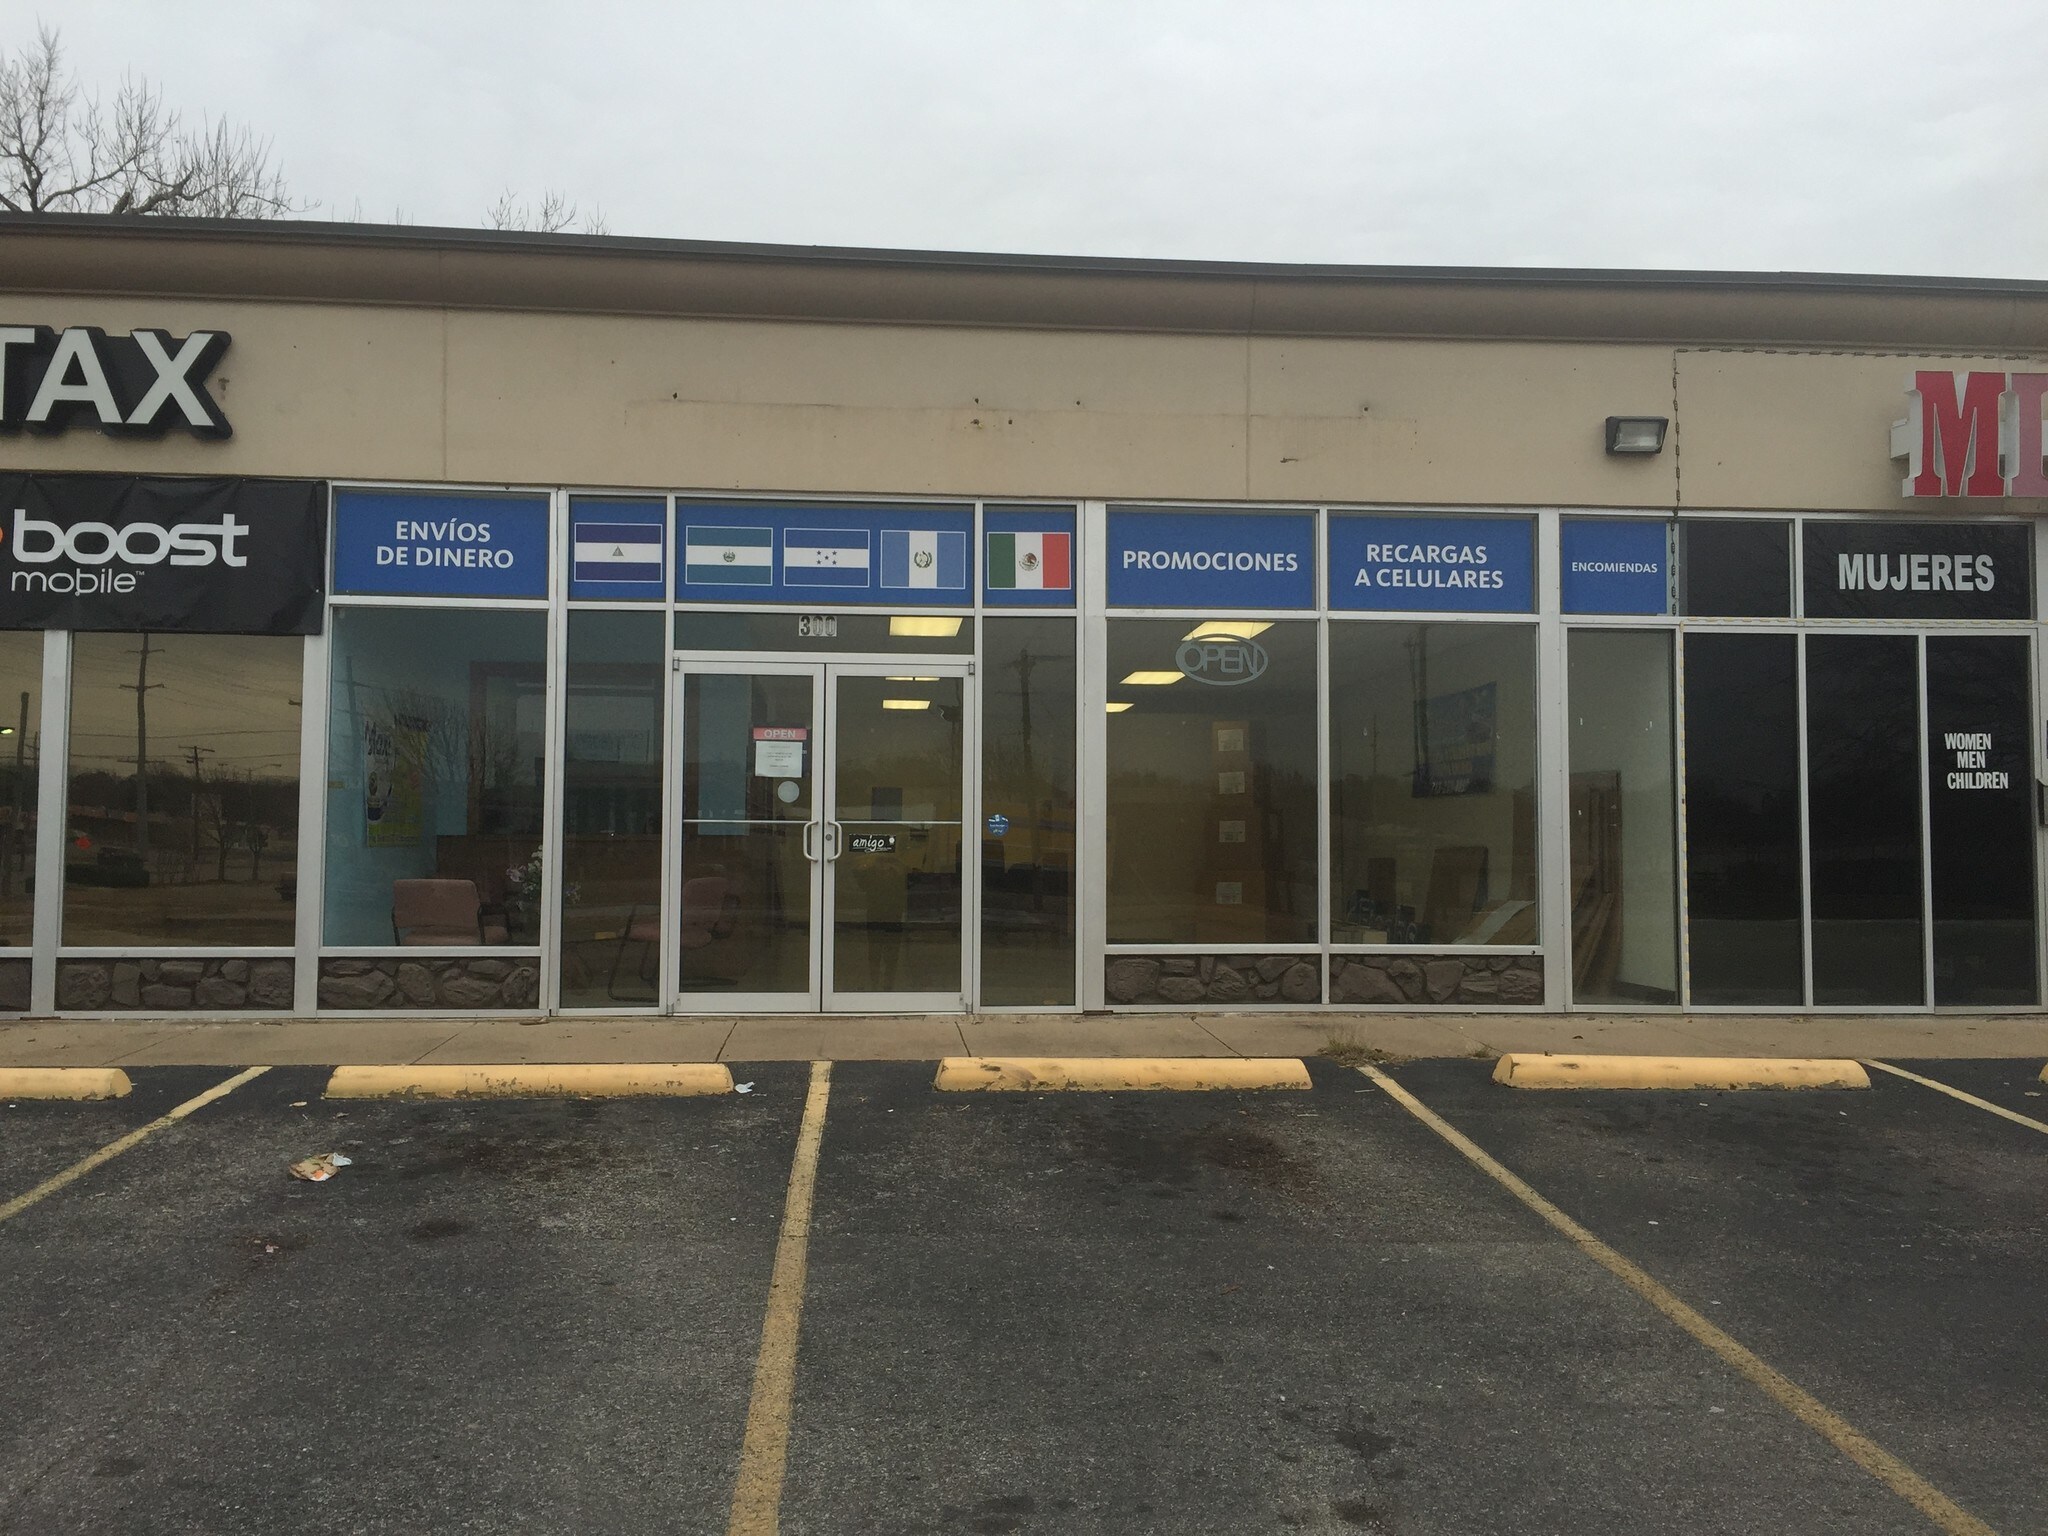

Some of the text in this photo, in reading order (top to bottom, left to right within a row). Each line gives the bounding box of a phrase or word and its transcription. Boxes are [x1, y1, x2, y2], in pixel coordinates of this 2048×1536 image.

[12, 509, 250, 567] boost
[396, 518, 491, 542] ENVÍOS
[376, 546, 514, 568] DE DINERO
[1122, 550, 1298, 572] PROMOCIONES
[1366, 544, 1487, 564] RECARGAS
[1572, 562, 1658, 574] ENCOMIENDAS
[1838, 553, 1996, 592] MUJERES
[1354, 569, 1504, 589] A CELULARES
[800, 615, 836, 636] 300
[1179, 643, 1260, 674] OPEN
[763, 729, 796, 738] OPEN
[1944, 732, 1992, 750] WOMEN
[1956, 751, 1986, 769] MEN
[1946, 772, 2009, 790] CHILDREN
[852, 834, 885, 852] amigo
